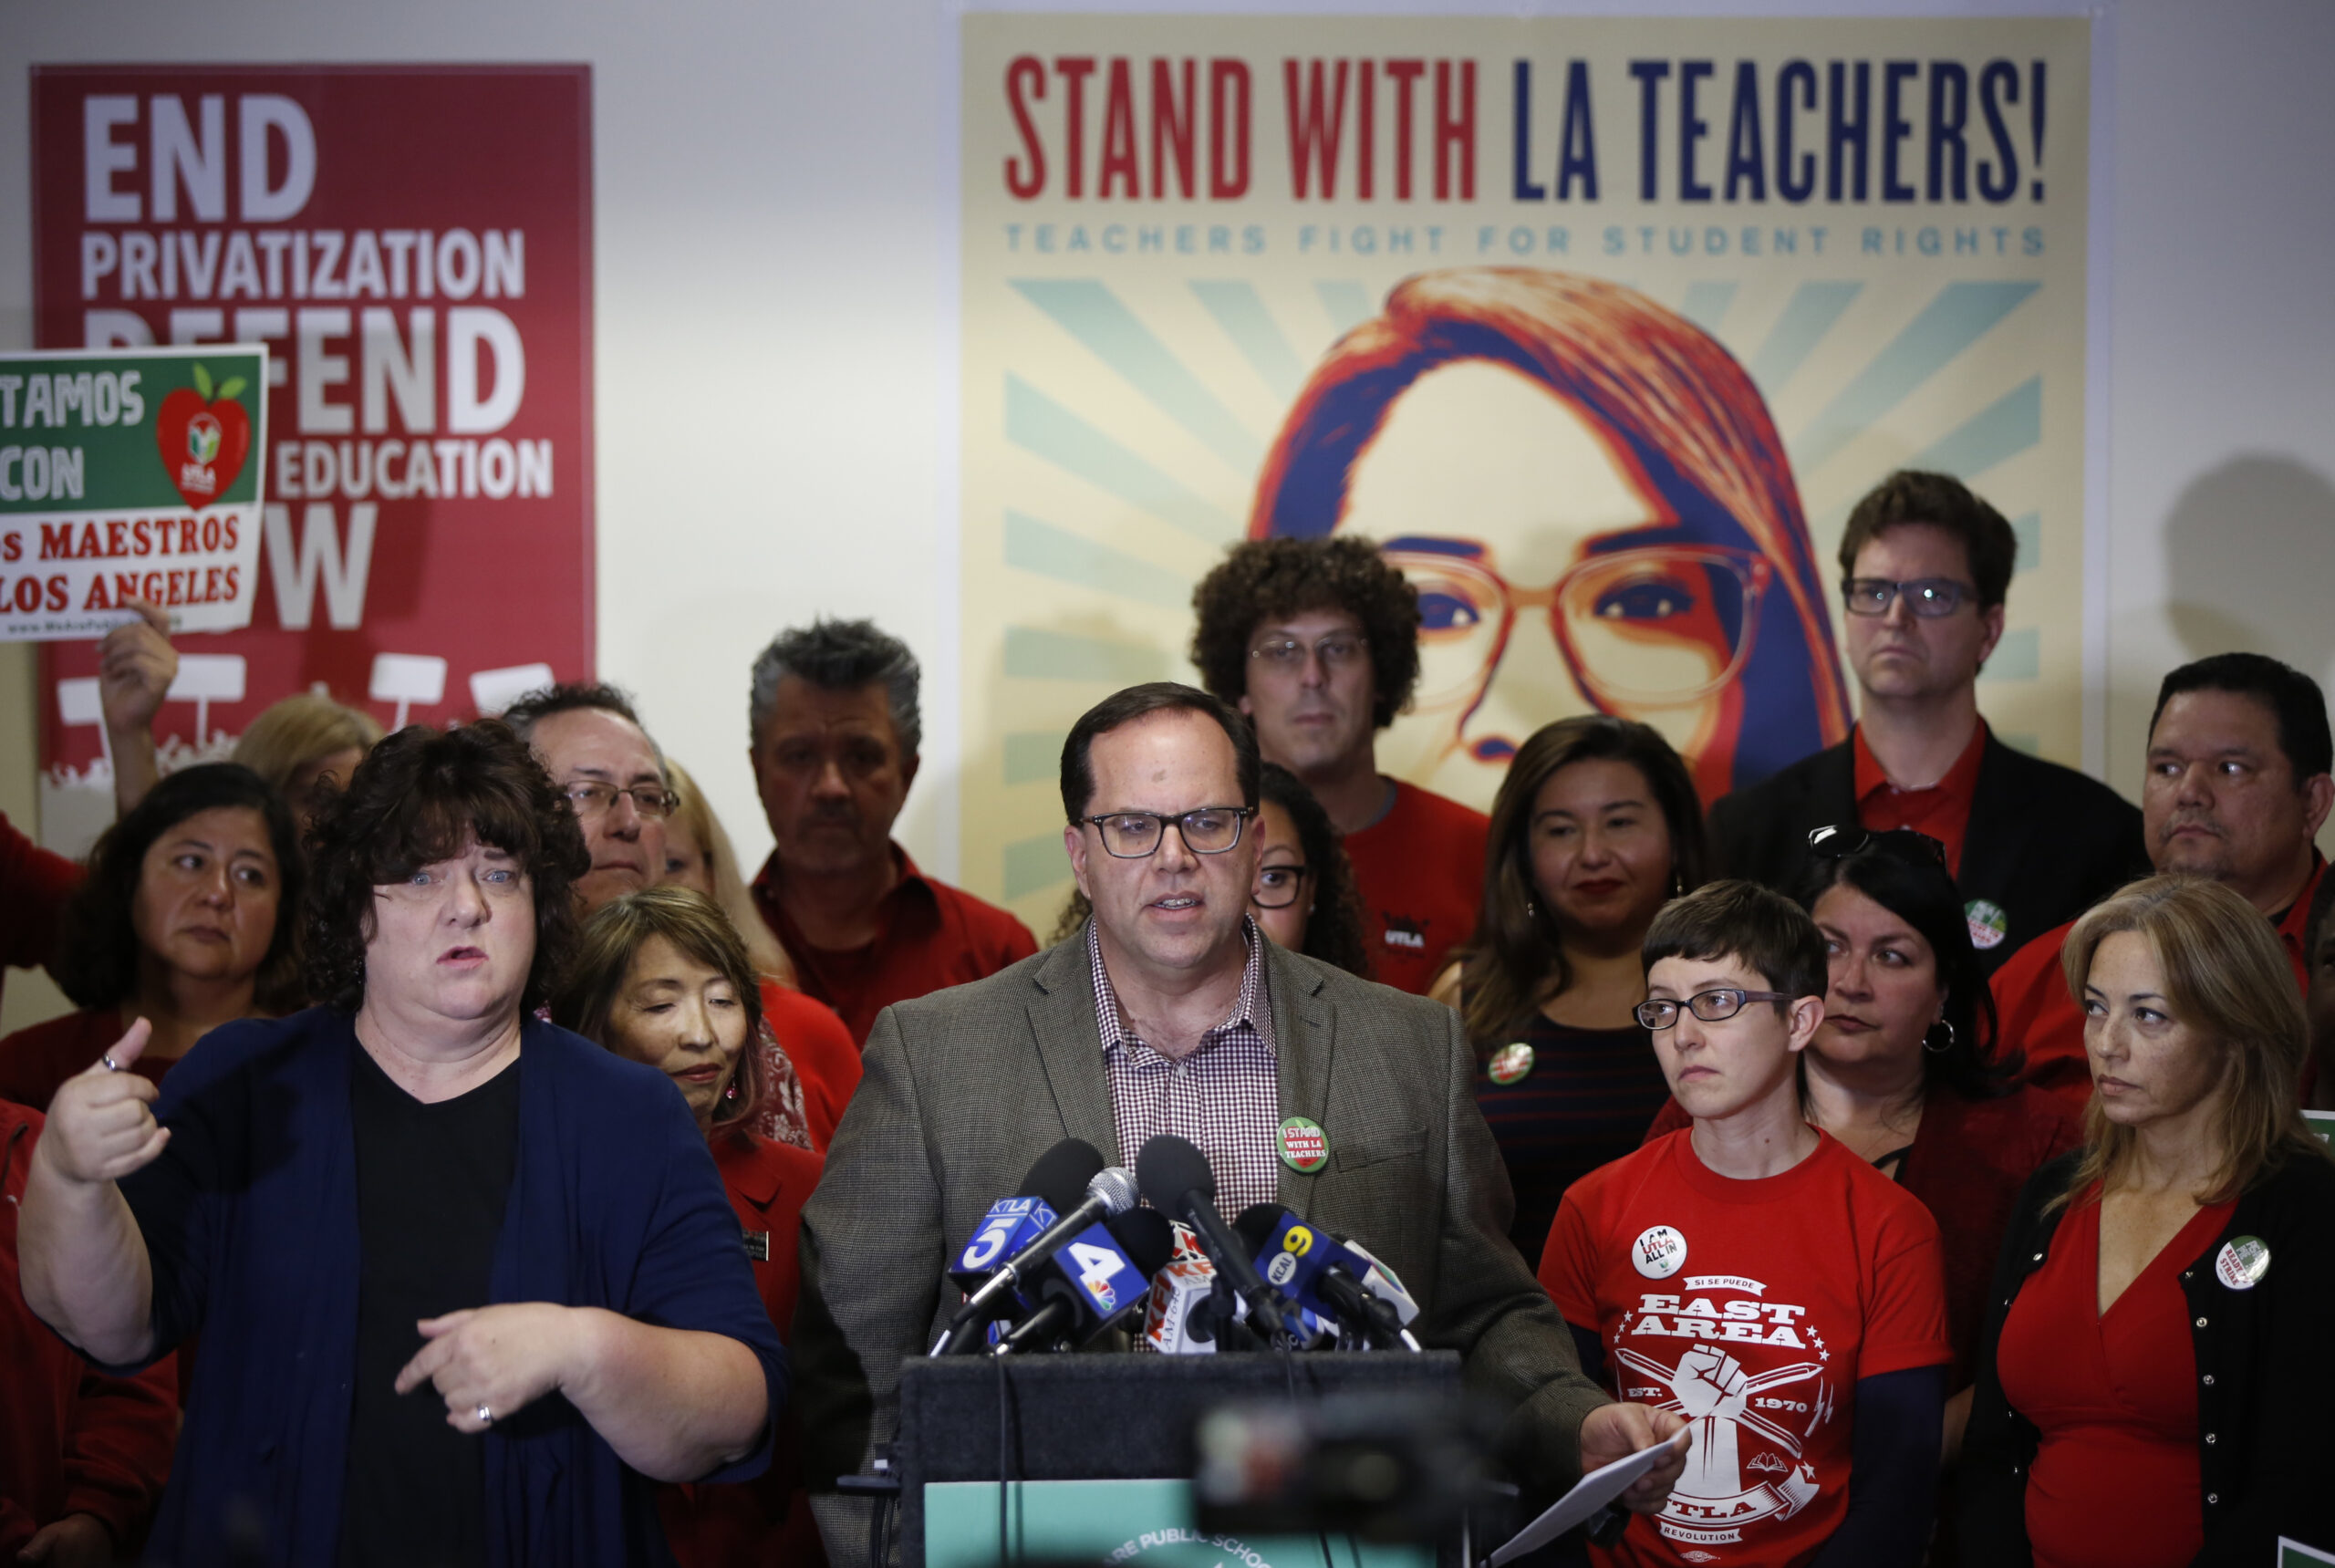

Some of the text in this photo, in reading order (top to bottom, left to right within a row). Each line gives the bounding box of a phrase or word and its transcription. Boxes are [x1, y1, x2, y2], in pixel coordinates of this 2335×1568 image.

[1002, 54, 2046, 203] STAND WITH LA TEACHERS!
[83, 93, 317, 223] END
[1004, 224, 2046, 255] TEACHERS FIGHT FOR STUDENT RIGHTS
[81, 228, 526, 300] PRIVATIZATION
[0, 445, 85, 501] CON
[276, 440, 554, 499] EDUCATION
[38, 514, 240, 561] MAESTROS
[83, 565, 240, 611] ANGELES
[1286, 1139, 1322, 1148] WITH LA
[1287, 1127, 1321, 1138] STAND
[1284, 1149, 1326, 1158] TEACHERS
[990, 1198, 1032, 1213] KTLA
[961, 1218, 1018, 1269] 5
[1282, 1225, 1314, 1258] 9
[1642, 1237, 1675, 1255] UTLA
[1649, 1228, 1668, 1243] AM
[1068, 1241, 1126, 1292] 4
[1645, 1242, 1678, 1264] ALL IN
[2226, 1248, 2244, 1272] READY
[1271, 1255, 1293, 1282] KCAL
[2219, 1257, 2240, 1286] STRIKE
[1723, 1278, 1755, 1289] PUEDE
[1637, 1293, 1806, 1325] EAST
[1631, 1315, 1807, 1350] AREA
[1627, 1386, 1663, 1397] EST.
[1754, 1397, 1808, 1413] 1970
[1667, 1498, 1757, 1519] TLA
[1663, 1526, 1736, 1542] REVOLUTION
